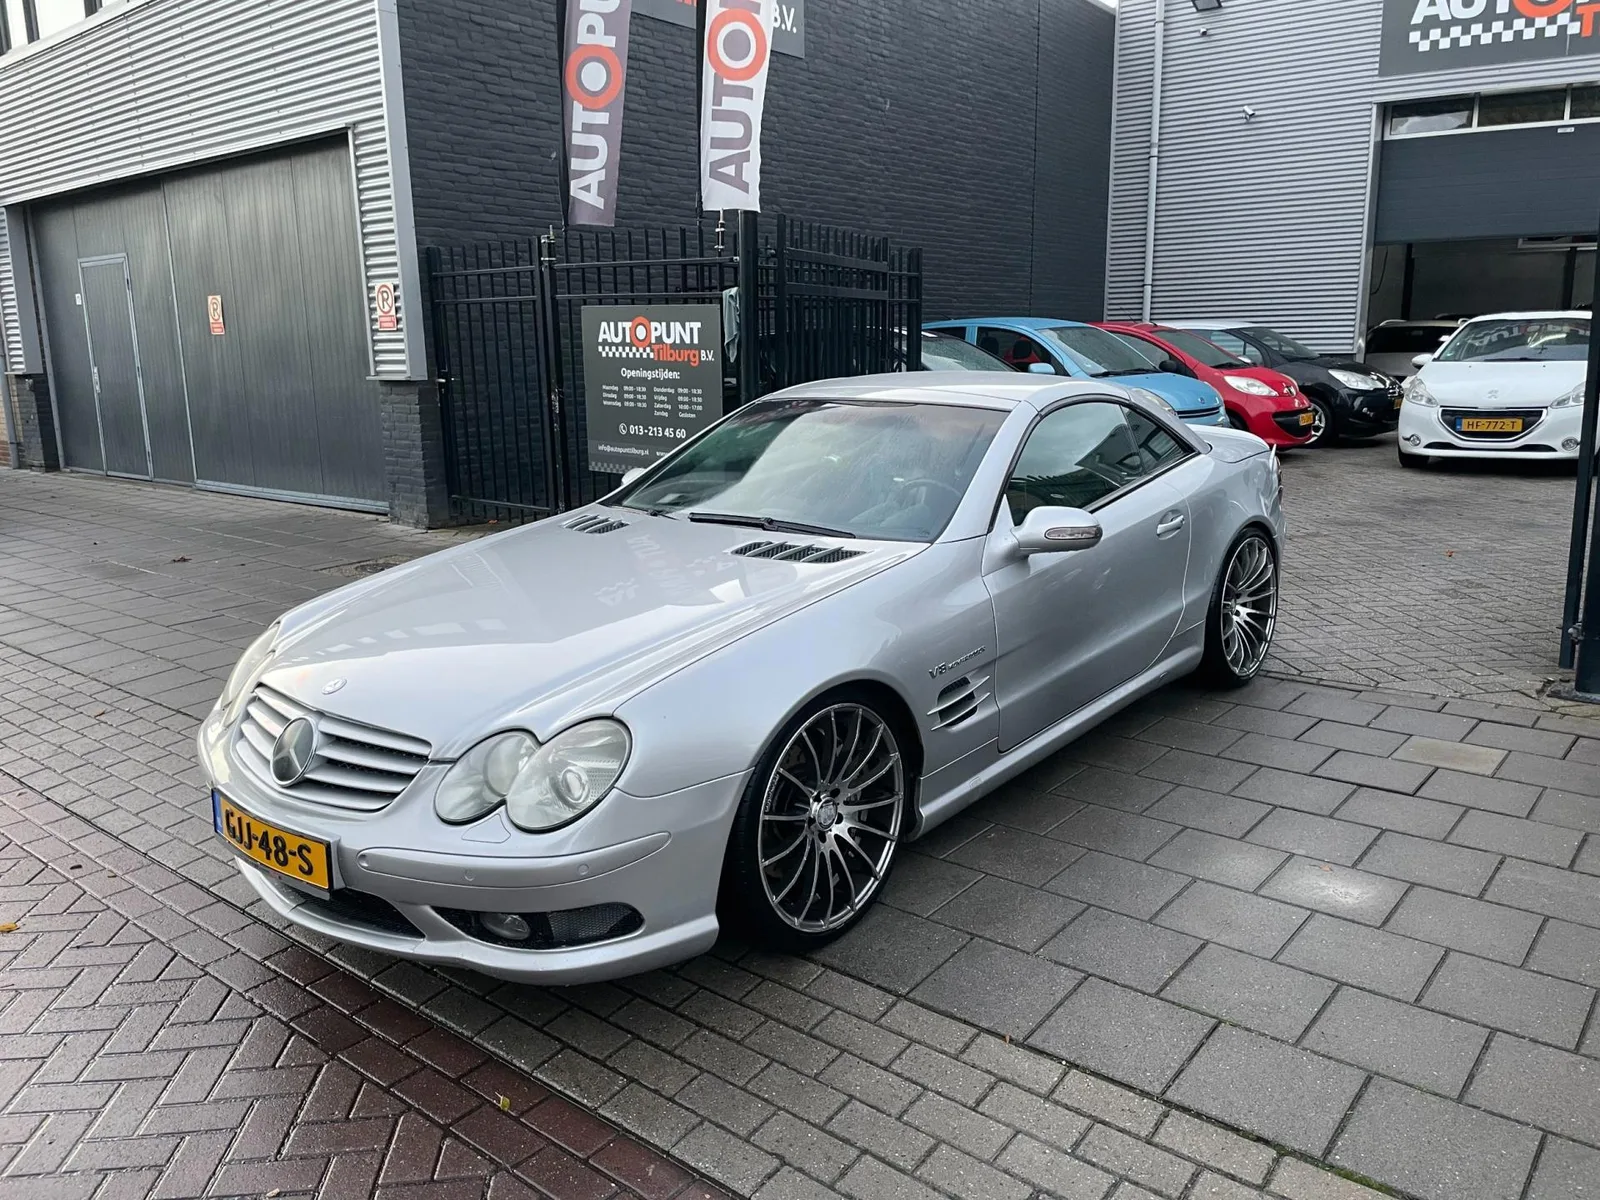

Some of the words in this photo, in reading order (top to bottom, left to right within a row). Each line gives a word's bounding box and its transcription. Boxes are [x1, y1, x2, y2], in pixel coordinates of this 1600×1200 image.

[707, 0, 767, 195] AUTO
[598, 315, 702, 348] AUTOPUNT
[652, 344, 700, 367] Tilburg
[701, 350, 715, 361] B.V.
[621, 368, 681, 380] Openingstijden:
[664, 428, 674, 438] 45
[676, 429, 686, 439] 60
[1467, 420, 1517, 430] HF-772-T
[928, 662, 946, 679] V8
[225, 808, 313, 876] GJJ-48-S
